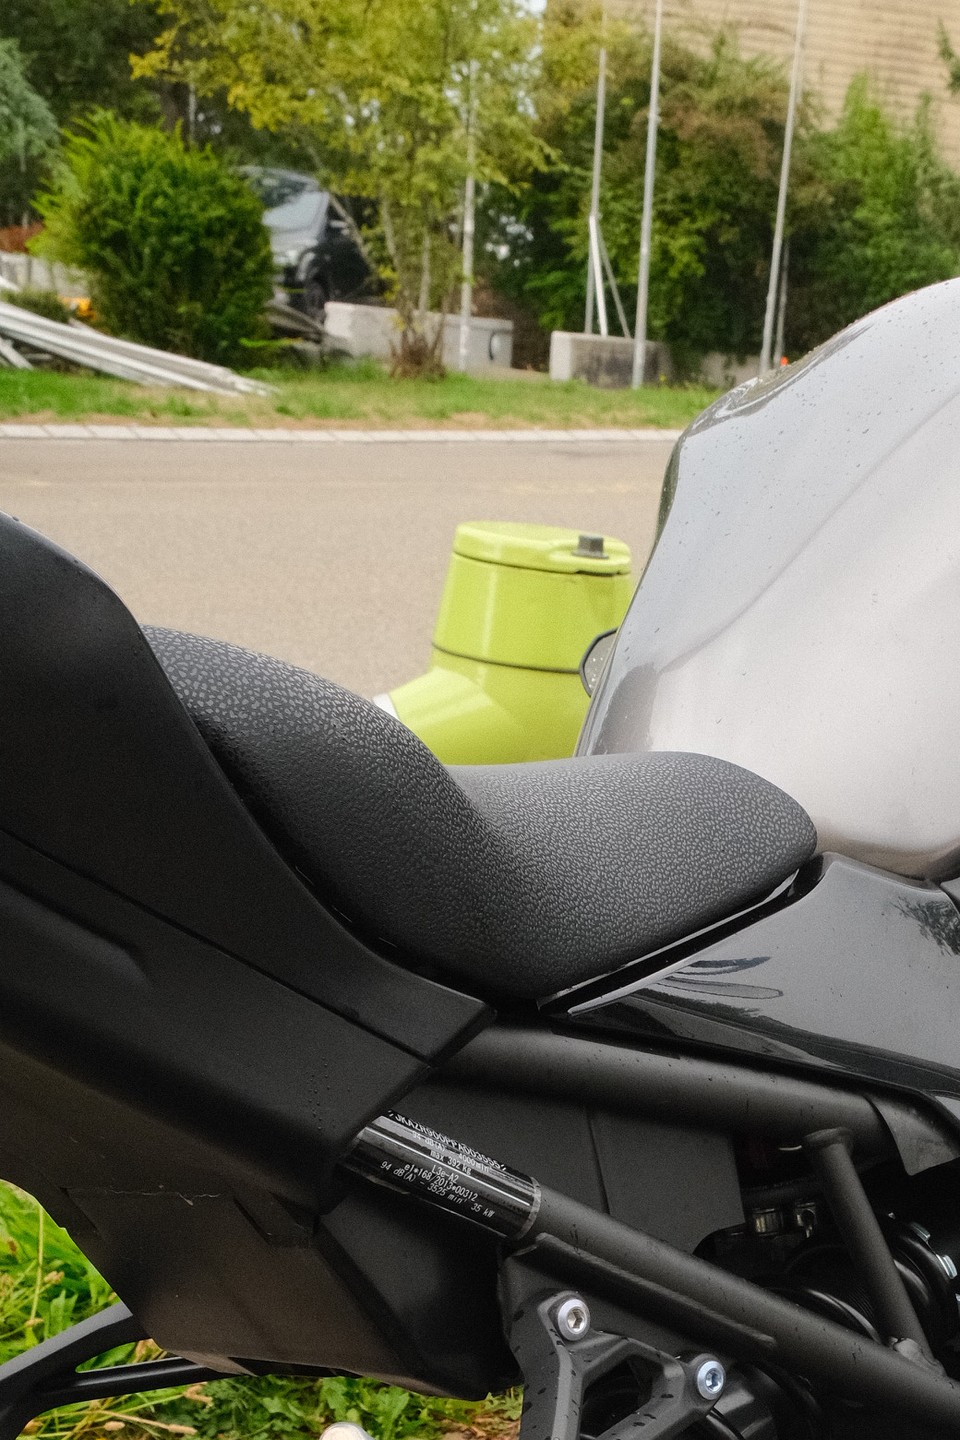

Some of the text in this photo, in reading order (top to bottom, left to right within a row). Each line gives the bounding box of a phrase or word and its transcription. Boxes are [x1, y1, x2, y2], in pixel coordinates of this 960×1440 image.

[430, 1150, 444, 1161] max
[447, 1156, 461, 1170] 392
[431, 1164, 460, 1184] L3e-A2
[380, 1160, 392, 1171] 94
[393, 1167, 416, 1182] dB(A)
[427, 1182, 447, 1197] 3525
[470, 1202, 483, 1213] 35
[482, 1207, 496, 1218] kW
